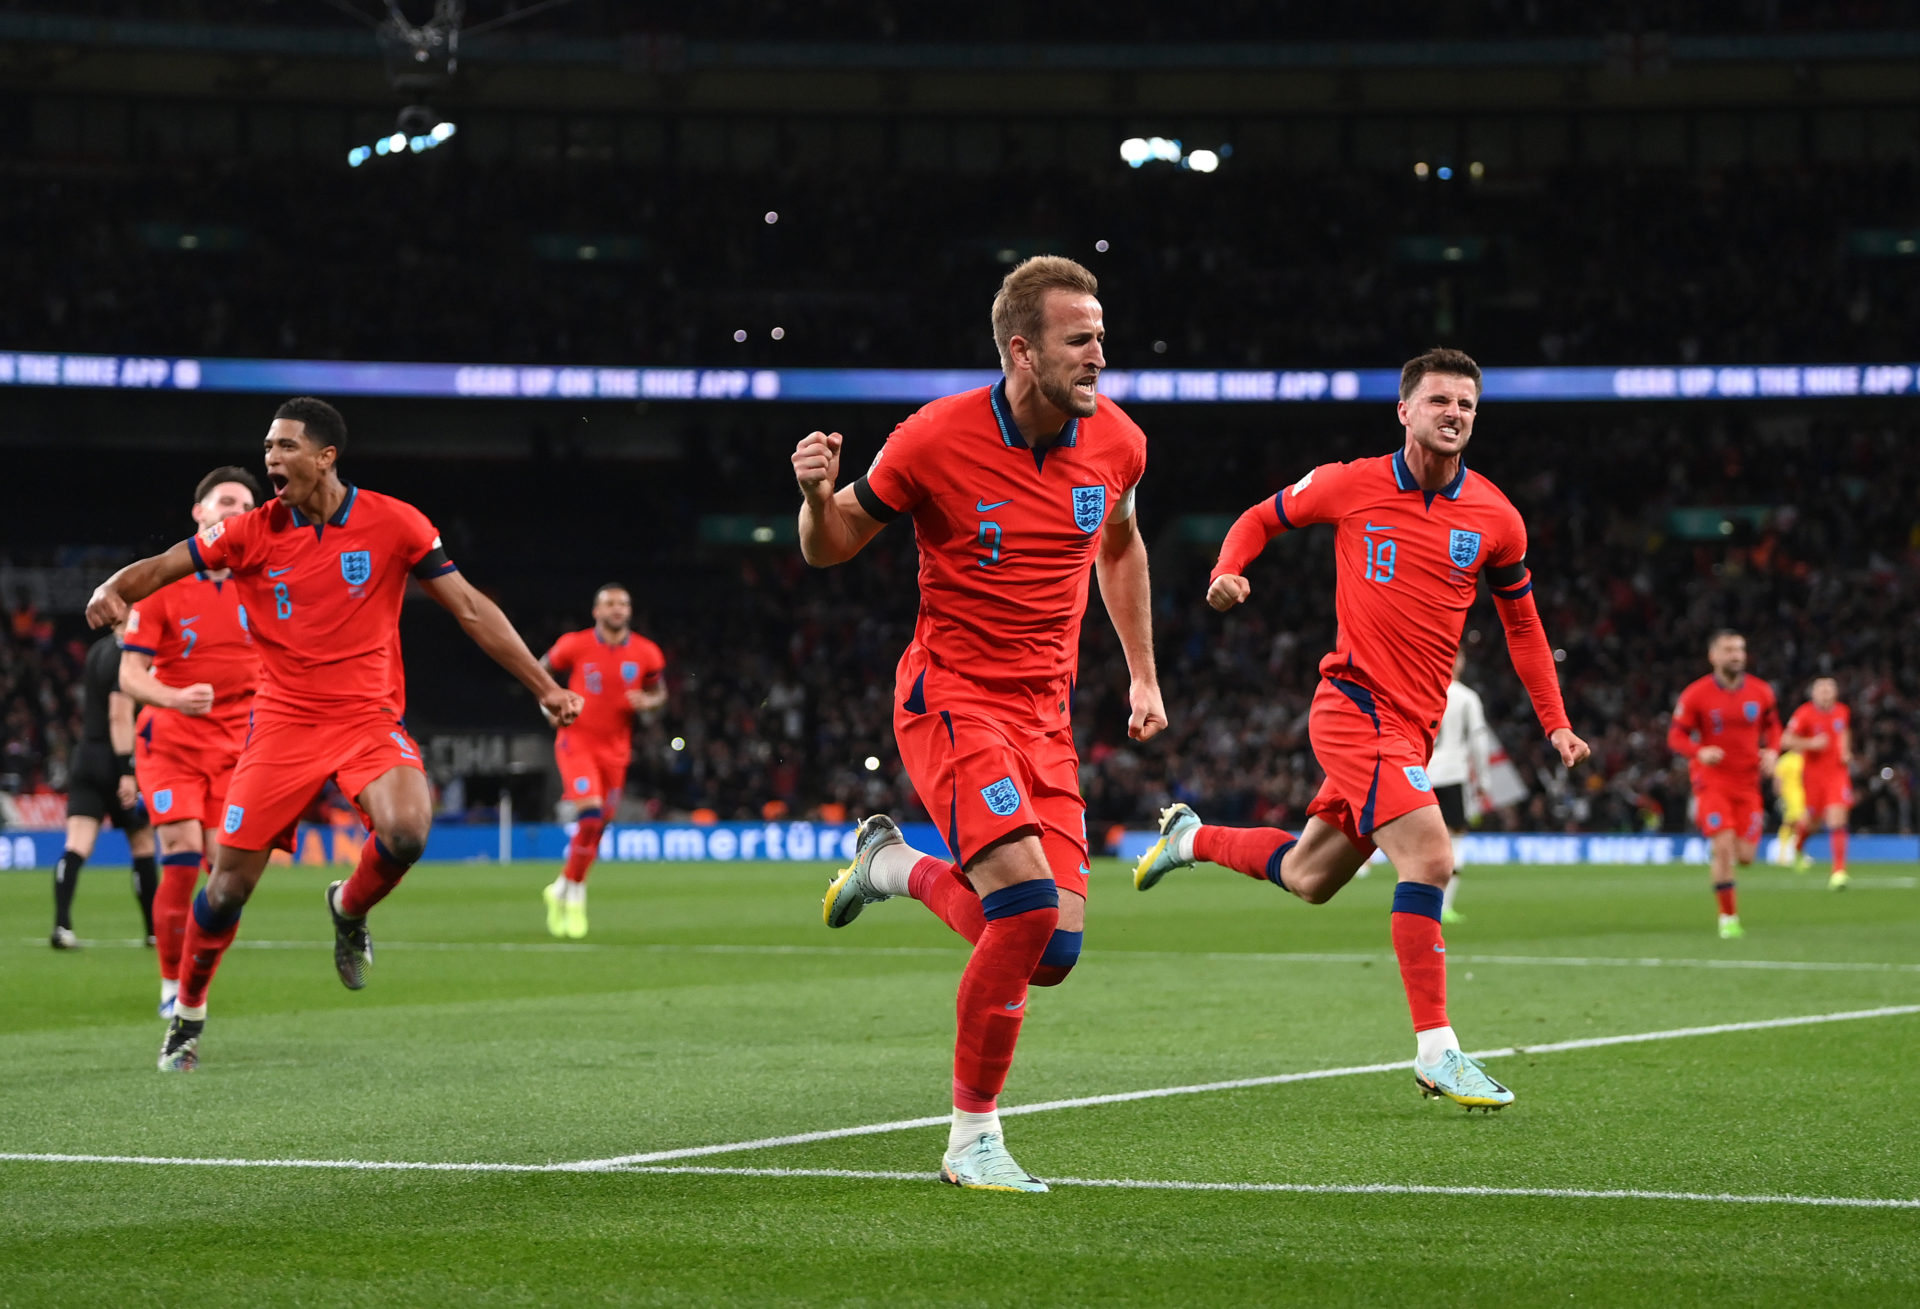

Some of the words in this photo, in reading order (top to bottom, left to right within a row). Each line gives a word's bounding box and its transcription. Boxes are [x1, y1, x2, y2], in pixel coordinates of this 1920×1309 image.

[120, 357, 168, 388] APP
[520, 367, 553, 397] UP
[556, 367, 594, 397] ON
[597, 368, 638, 398] THE
[641, 368, 696, 398] NIKE
[699, 369, 748, 399] APP
[1136, 371, 1174, 400] ON
[1177, 371, 1217, 400] THE
[1220, 371, 1276, 400] NIKE
[1278, 371, 1328, 400] APP
[1679, 367, 1714, 397] UP
[1716, 367, 1755, 396] ON
[1758, 366, 1799, 396] THE
[1802, 366, 1859, 396] NIKE
[1862, 365, 1912, 395] APP
[977, 520, 1002, 567] 9
[1363, 536, 1397, 583] 19
[273, 581, 292, 620] 8
[180, 628, 198, 659] 7
